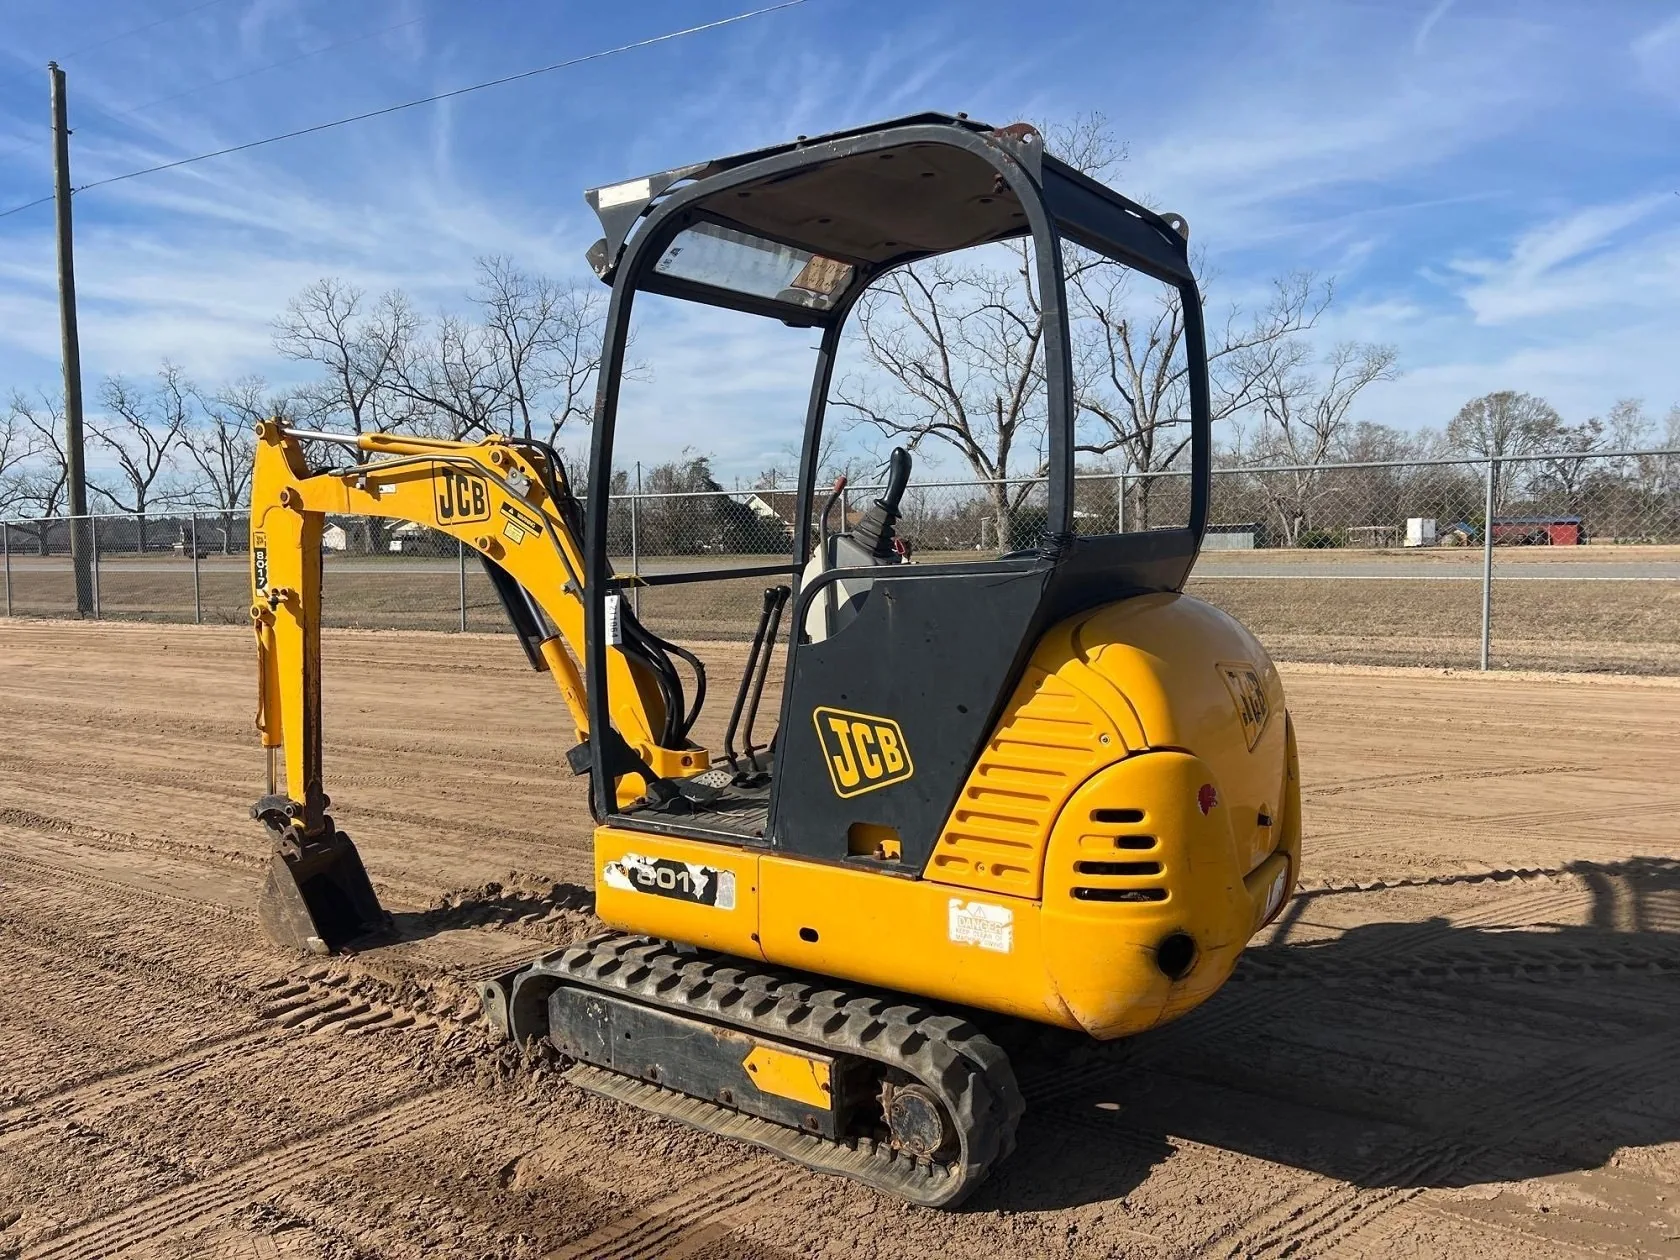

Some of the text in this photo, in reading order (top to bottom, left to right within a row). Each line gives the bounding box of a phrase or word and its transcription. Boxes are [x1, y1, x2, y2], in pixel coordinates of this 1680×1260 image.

[440, 466, 485, 518] JCB
[256, 551, 265, 586] 8017
[828, 717, 904, 787] JCB
[957, 916, 1003, 935] DANGER
